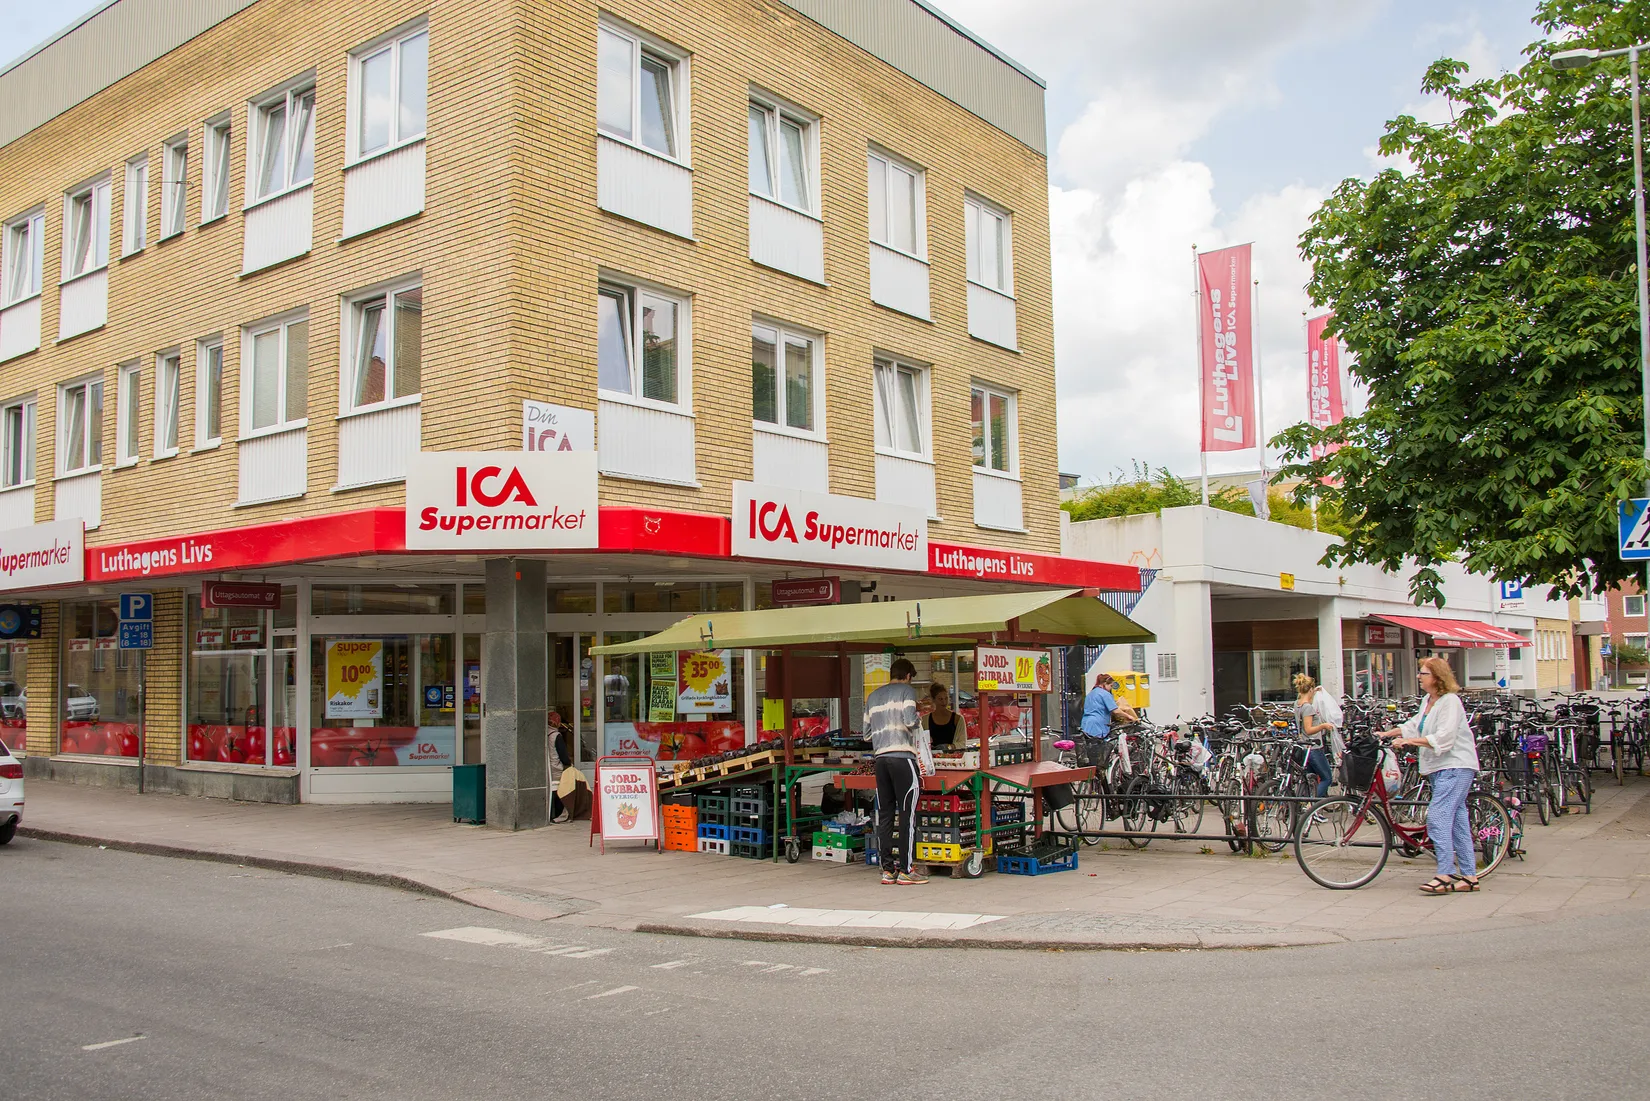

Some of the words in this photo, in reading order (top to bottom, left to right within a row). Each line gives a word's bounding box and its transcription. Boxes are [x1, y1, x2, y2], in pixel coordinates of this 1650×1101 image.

[1229, 256, 1237, 308] Supermarket
[1227, 309, 1236, 330] ICA
[1211, 288, 1228, 416] Luthagens
[1225, 331, 1239, 381] Livs
[528, 405, 558, 425] Din
[528, 427, 573, 451] ICA
[456, 465, 538, 507] ICA
[419, 505, 586, 535] Supermarket
[750, 499, 799, 543] ICA
[804, 511, 918, 551] Supermarket
[0, 538, 70, 576] upermarket
[101, 548, 177, 574] Luthagens
[181, 540, 212, 564] Livs
[935, 548, 1006, 576] Luthagens
[1010, 556, 1034, 576] Livs
[215, 591, 260, 600] Uttagsautomat
[776, 587, 815, 597] Uttagsautomat
[1505, 581, 1518, 597] P
[129, 596, 145, 617] P
[337, 643, 372, 654] super
[982, 654, 1009, 668] JORD-
[977, 670, 1014, 685] GUBBAR
[417, 743, 438, 753] ICA
[619, 739, 639, 749] ICA
[604, 784, 648, 794] GUBBAR
[610, 774, 641, 783] JORD-
